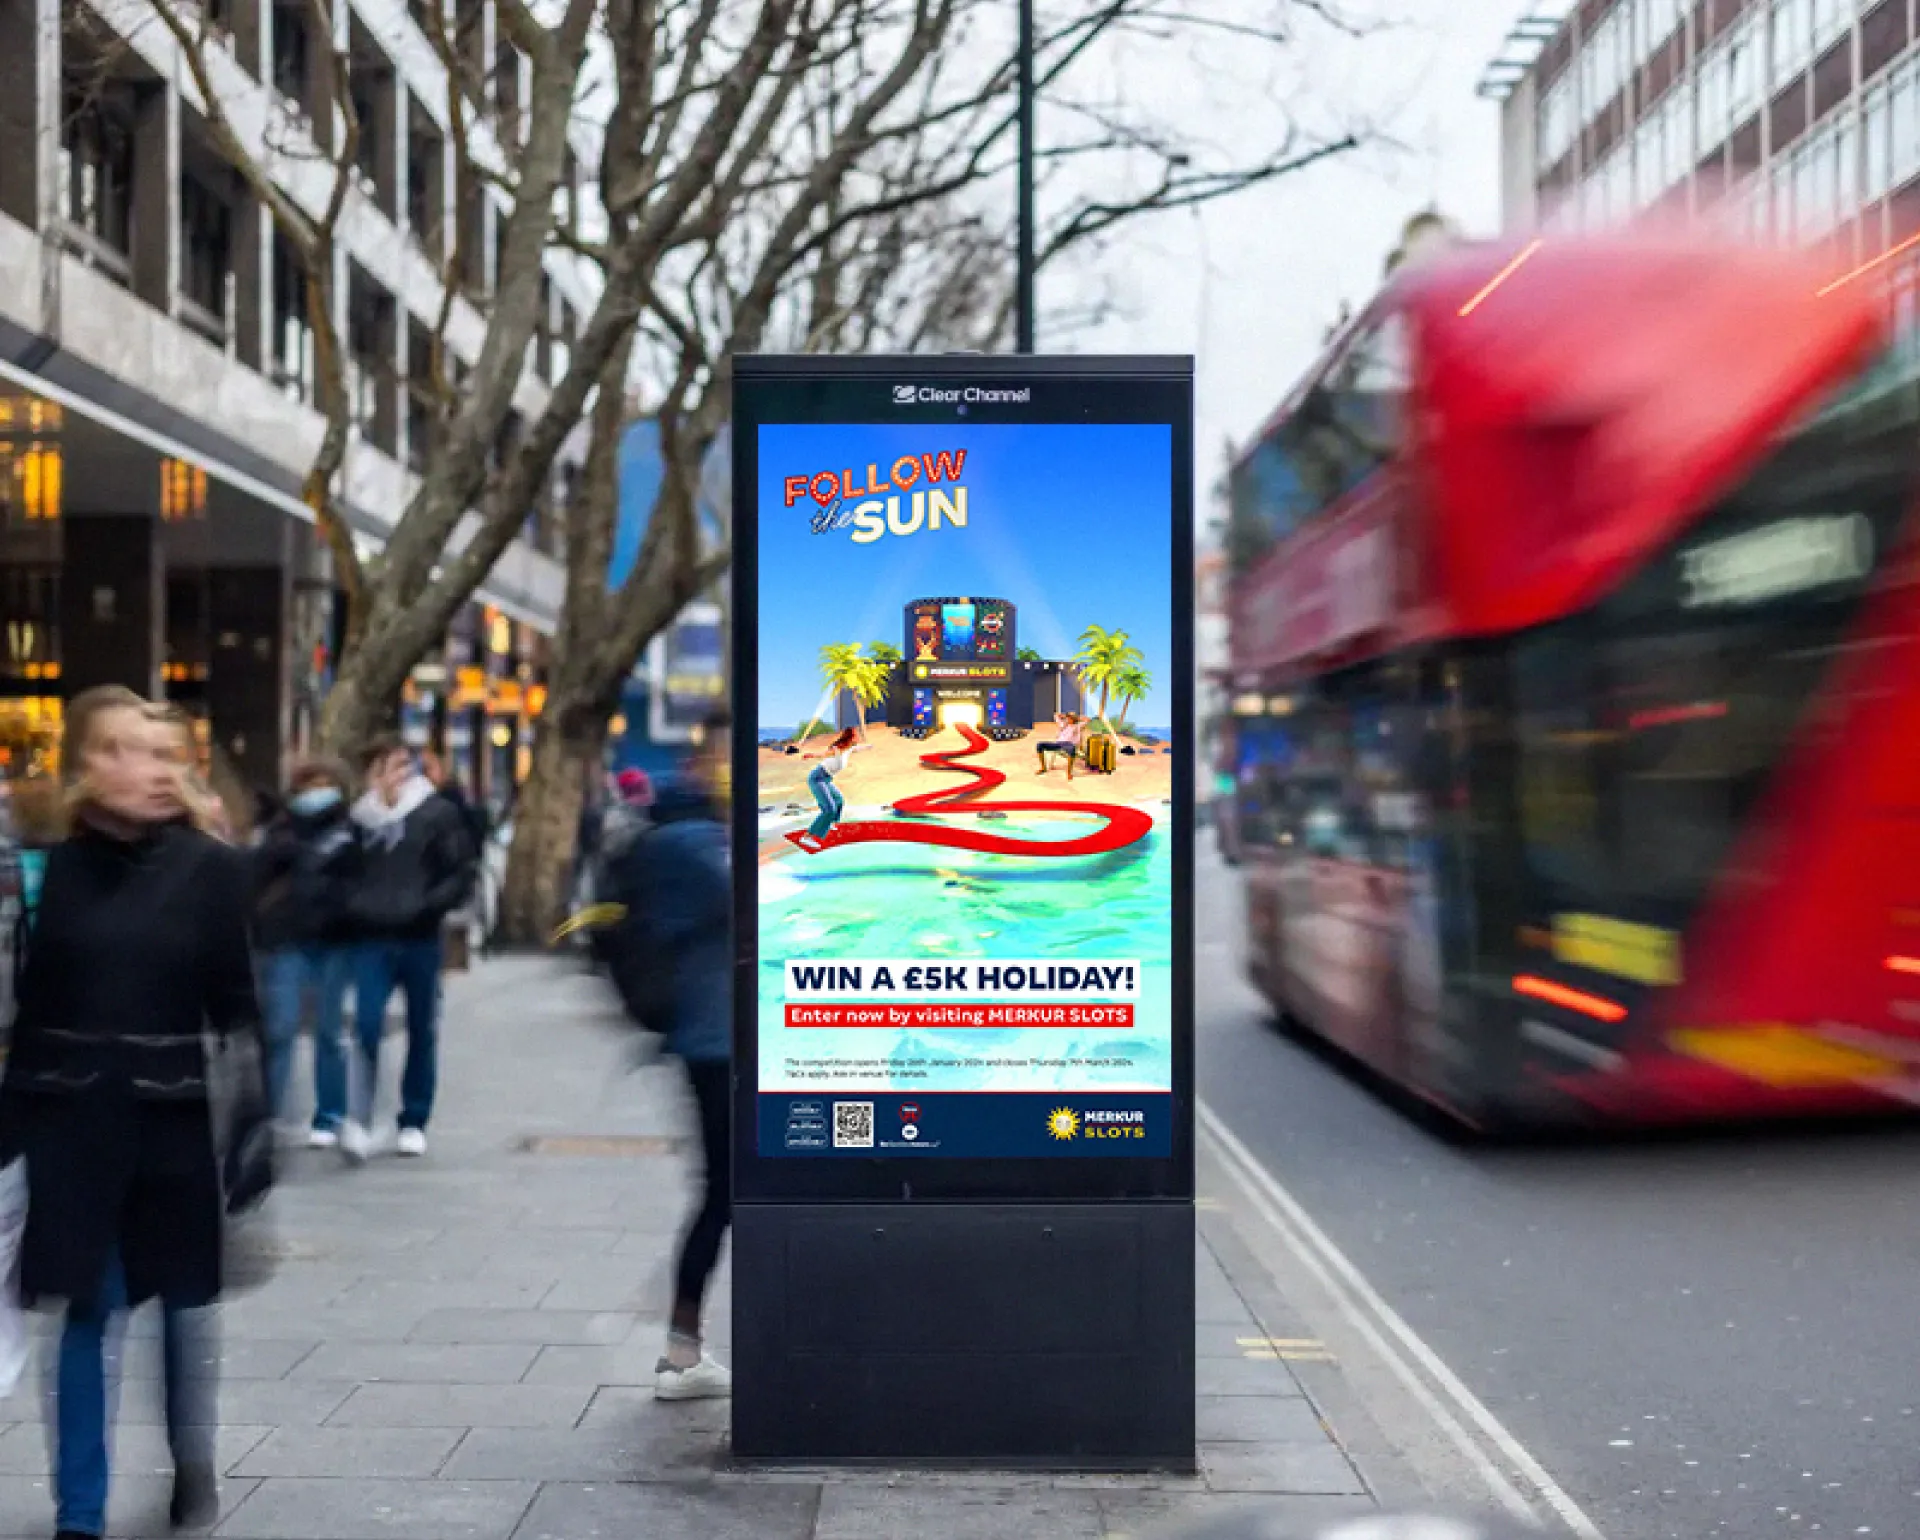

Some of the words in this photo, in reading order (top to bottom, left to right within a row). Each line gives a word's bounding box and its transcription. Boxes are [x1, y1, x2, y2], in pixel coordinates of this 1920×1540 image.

[918, 387, 959, 402] Clear
[964, 387, 1030, 402] Channel
[784, 449, 967, 508] FOLLOW
[809, 498, 855, 536] the
[851, 485, 968, 543] SUN
[792, 966, 862, 990] WIN
[871, 966, 895, 990] A
[903, 966, 967, 990] £5K
[978, 966, 1134, 990] HOLIDAY!
[791, 1008, 840, 1023] Enter
[847, 1011, 883, 1023] now
[889, 1008, 911, 1025] by
[916, 1008, 984, 1025] visiting
[988, 1008, 1065, 1023] MERKUR
[1070, 1008, 1127, 1023] SLOTS
[1085, 1110, 1144, 1123] MERKUR
[1085, 1127, 1145, 1138] SLOTS
